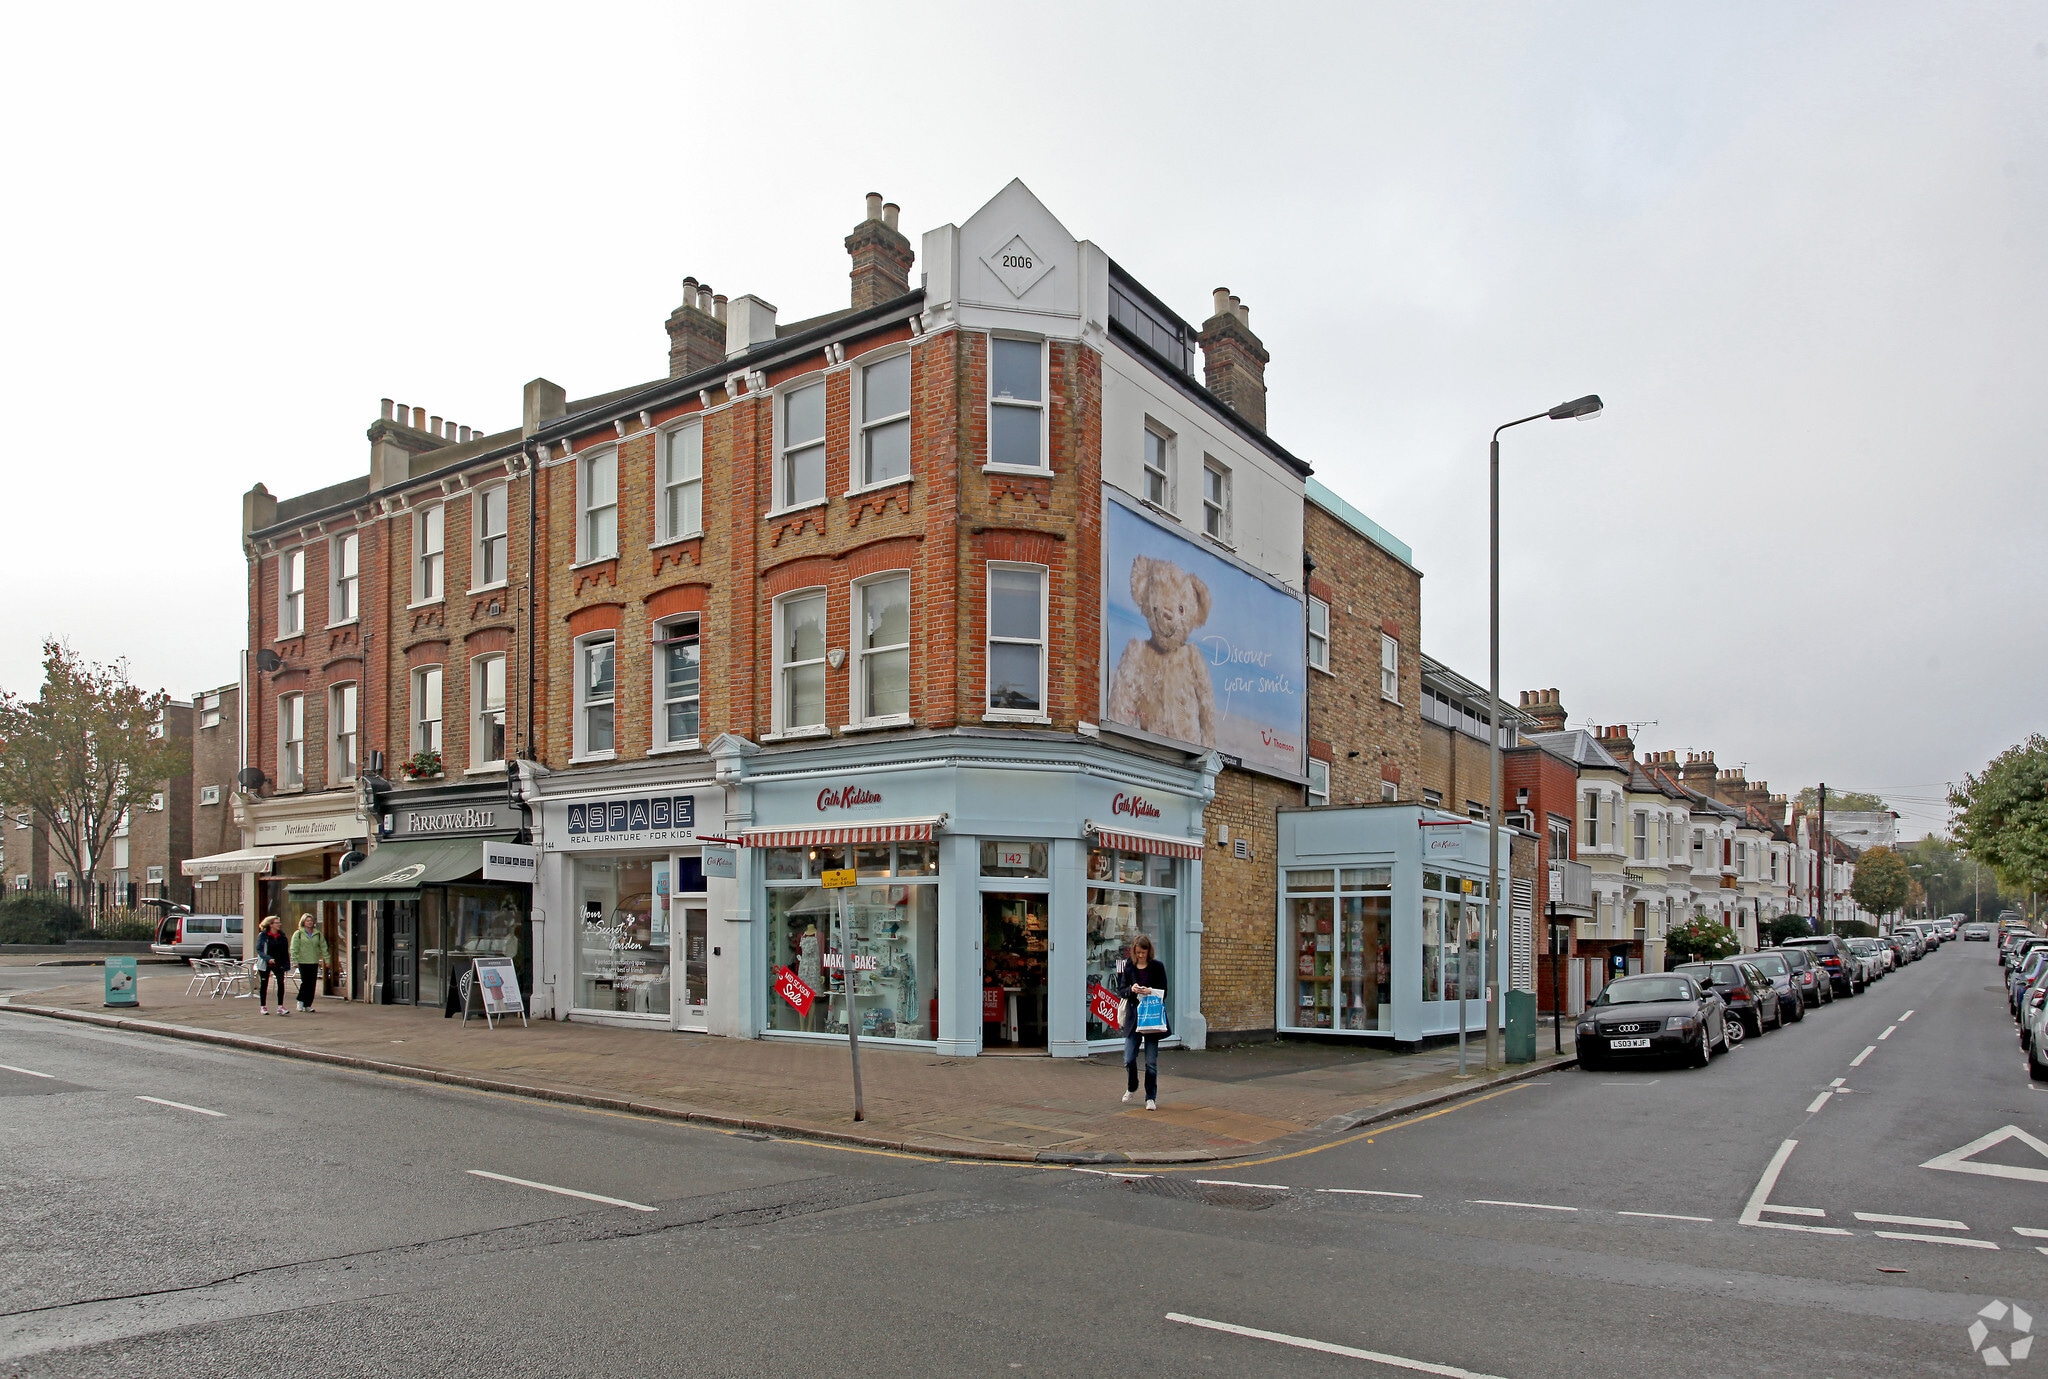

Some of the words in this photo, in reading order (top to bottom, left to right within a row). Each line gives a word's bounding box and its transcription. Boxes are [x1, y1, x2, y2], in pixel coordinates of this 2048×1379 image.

[1003, 255, 1032, 269] 2006
[1202, 635, 1272, 667] Discover
[1224, 677, 1254, 720] your
[1258, 674, 1294, 694] smile
[1273, 738, 1295, 752] Thomson
[1217, 753, 1238, 766] CDecaux
[817, 788, 840, 811] Cath
[840, 785, 882, 809] Kidston
[1112, 792, 1131, 815] Cath
[1131, 796, 1160, 818] Kidston
[568, 799, 692, 830] ASPACE
[570, 836, 591, 844] REAL
[594, 833, 640, 843] FURNITURE
[650, 832, 667, 840] FOR
[670, 830, 692, 839] KIDS
[1005, 853, 1022, 864] 142
[580, 904, 602, 924] Your
[595, 920, 625, 935] Secret
[609, 936, 642, 956] Garden
[855, 955, 877, 970] BAKE
[1616, 956, 1622, 966] P
[785, 972, 793, 983] MID
[793, 980, 811, 998] SEASON
[783, 984, 802, 1006] Sale
[1098, 990, 1106, 1000] MID
[1097, 1000, 1115, 1022] Sale
[1613, 1040, 1631, 1048] LS03
